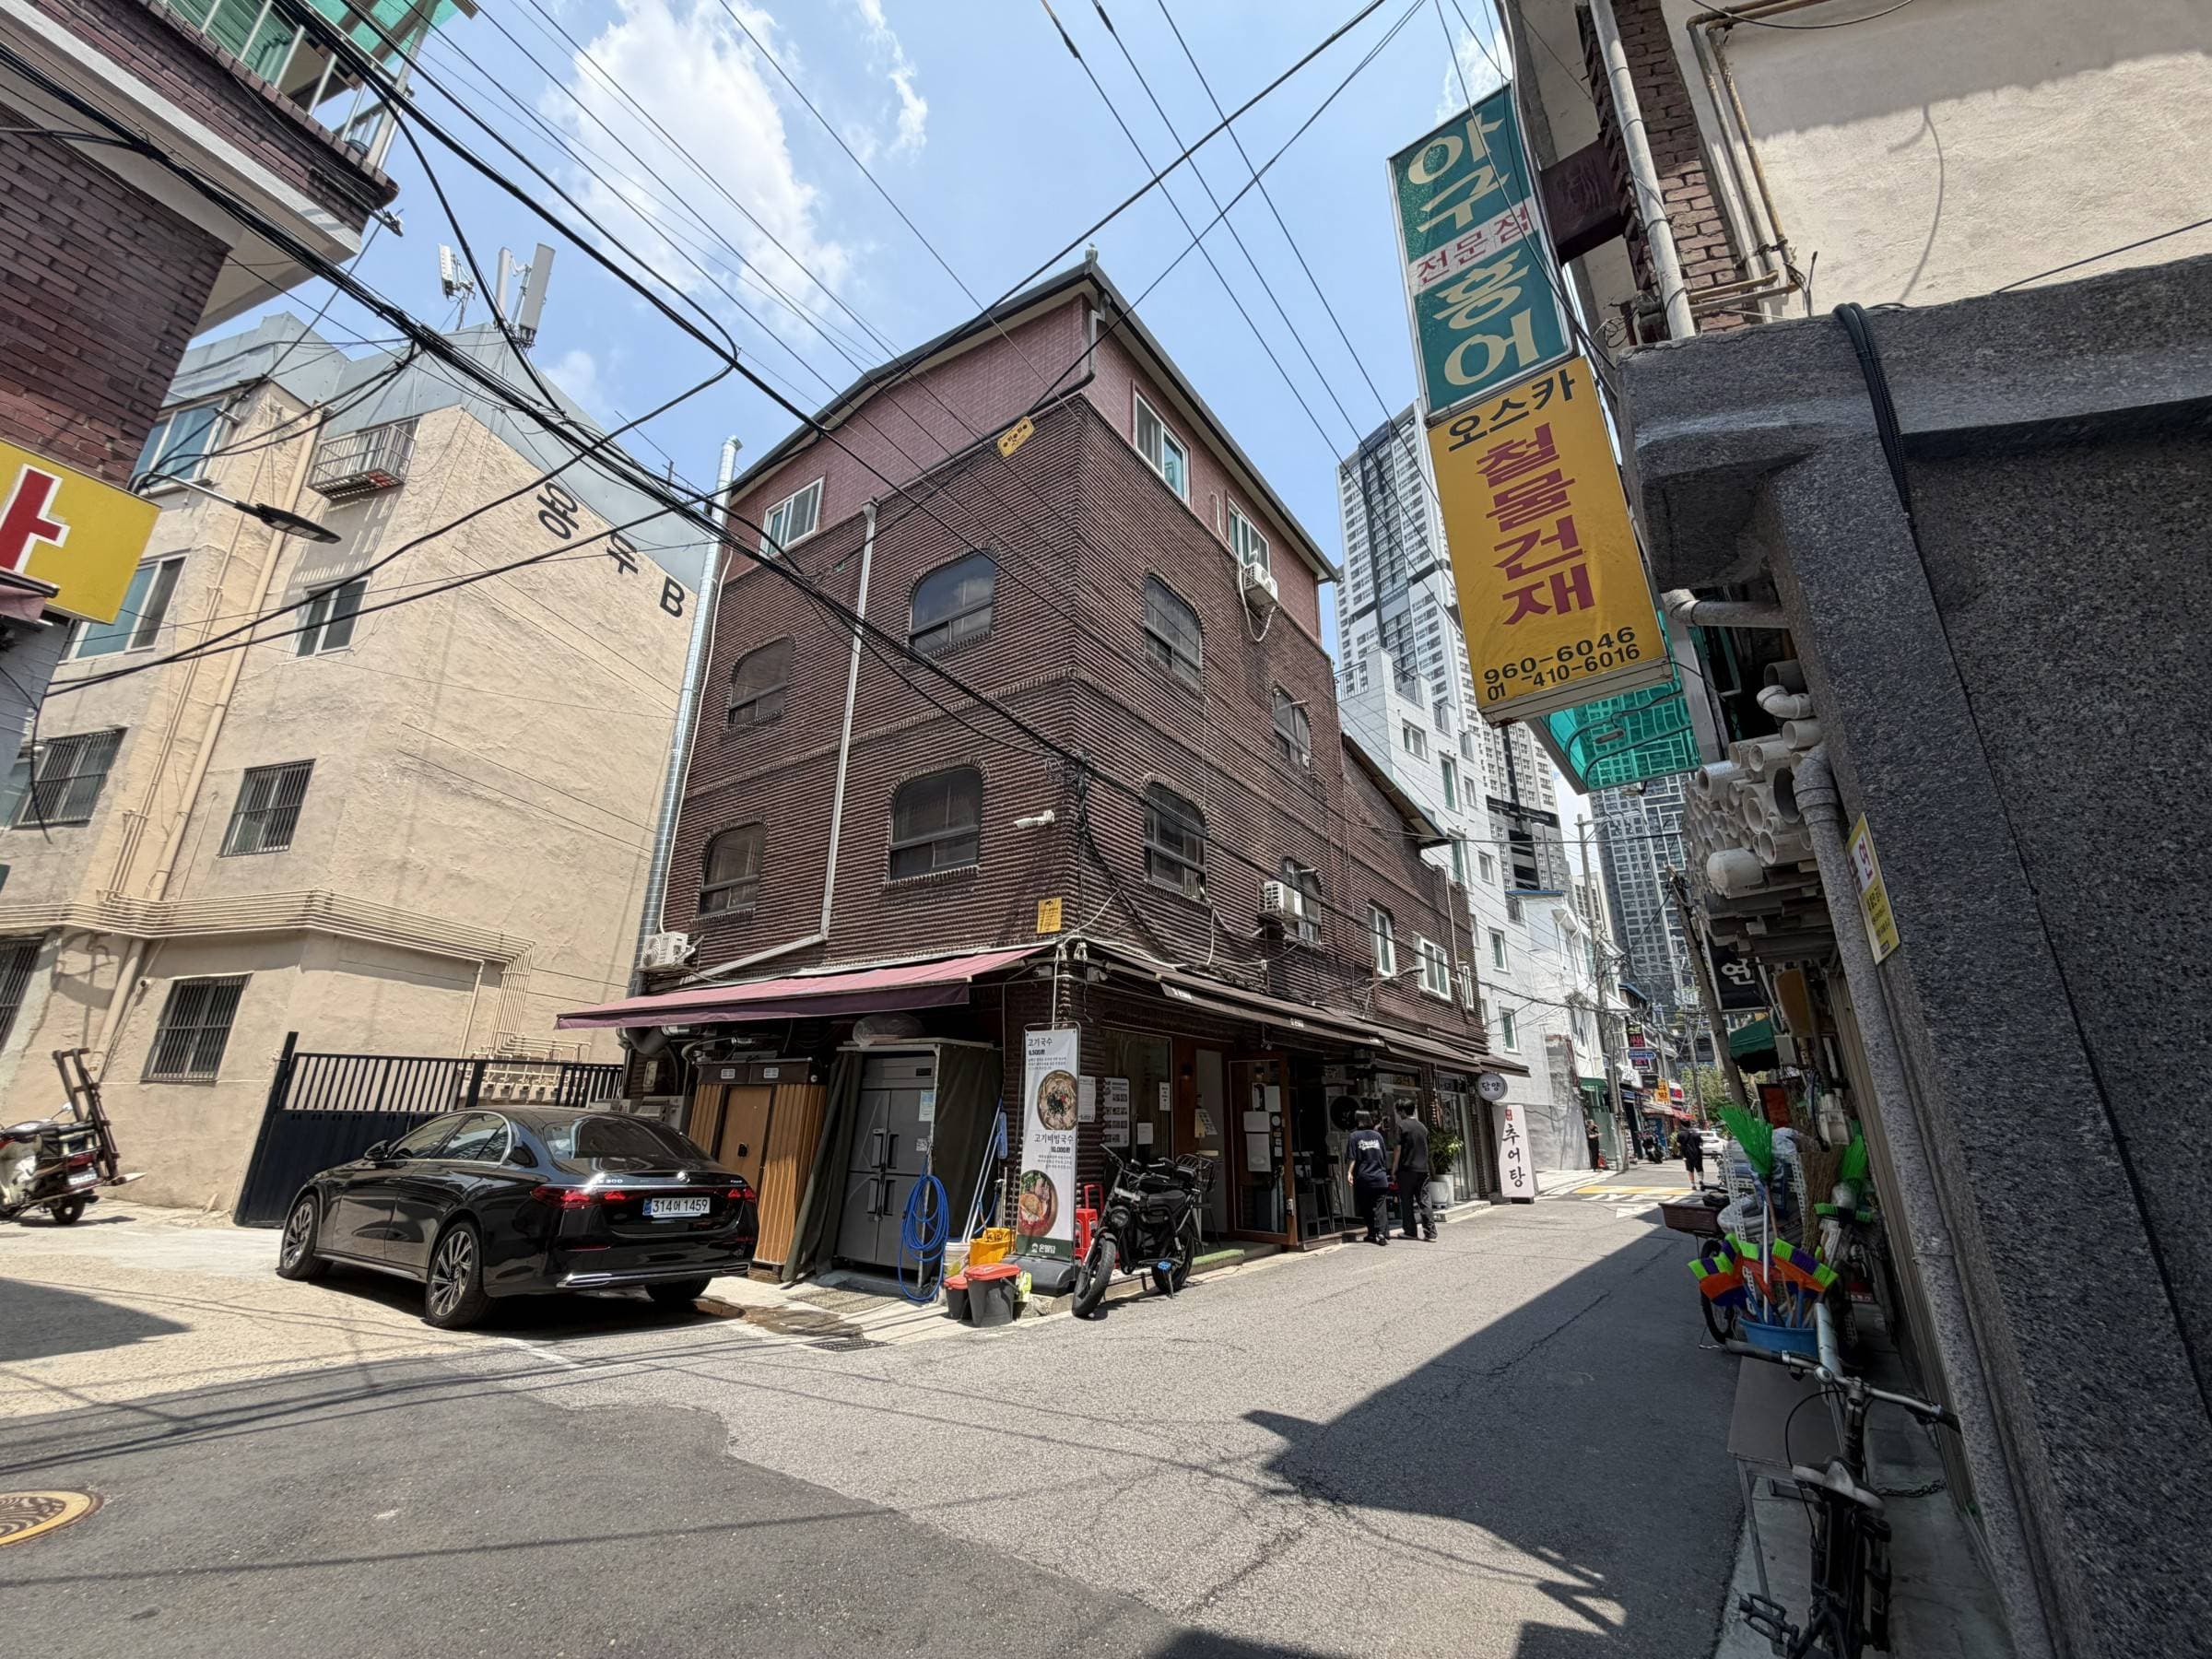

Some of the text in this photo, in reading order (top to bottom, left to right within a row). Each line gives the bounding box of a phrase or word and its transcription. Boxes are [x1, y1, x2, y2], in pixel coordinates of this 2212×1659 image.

[1407, 112, 1510, 233] 아구
[1418, 206, 1529, 285] 전문점
[1432, 249, 1540, 386] 홍어
[1448, 371, 1576, 452] 오스카
[1477, 422, 1595, 625] 철물건재
[1484, 626, 1636, 684] 960-6046
[1028, 1037, 1053, 1047] 고기국수
[1481, 1081, 1501, 1092] 담양
[1032, 1133, 1075, 1145] 고기비빔국수
[1502, 1123, 1526, 1188] 추어탕
[684, 1198, 708, 1213] 1459
